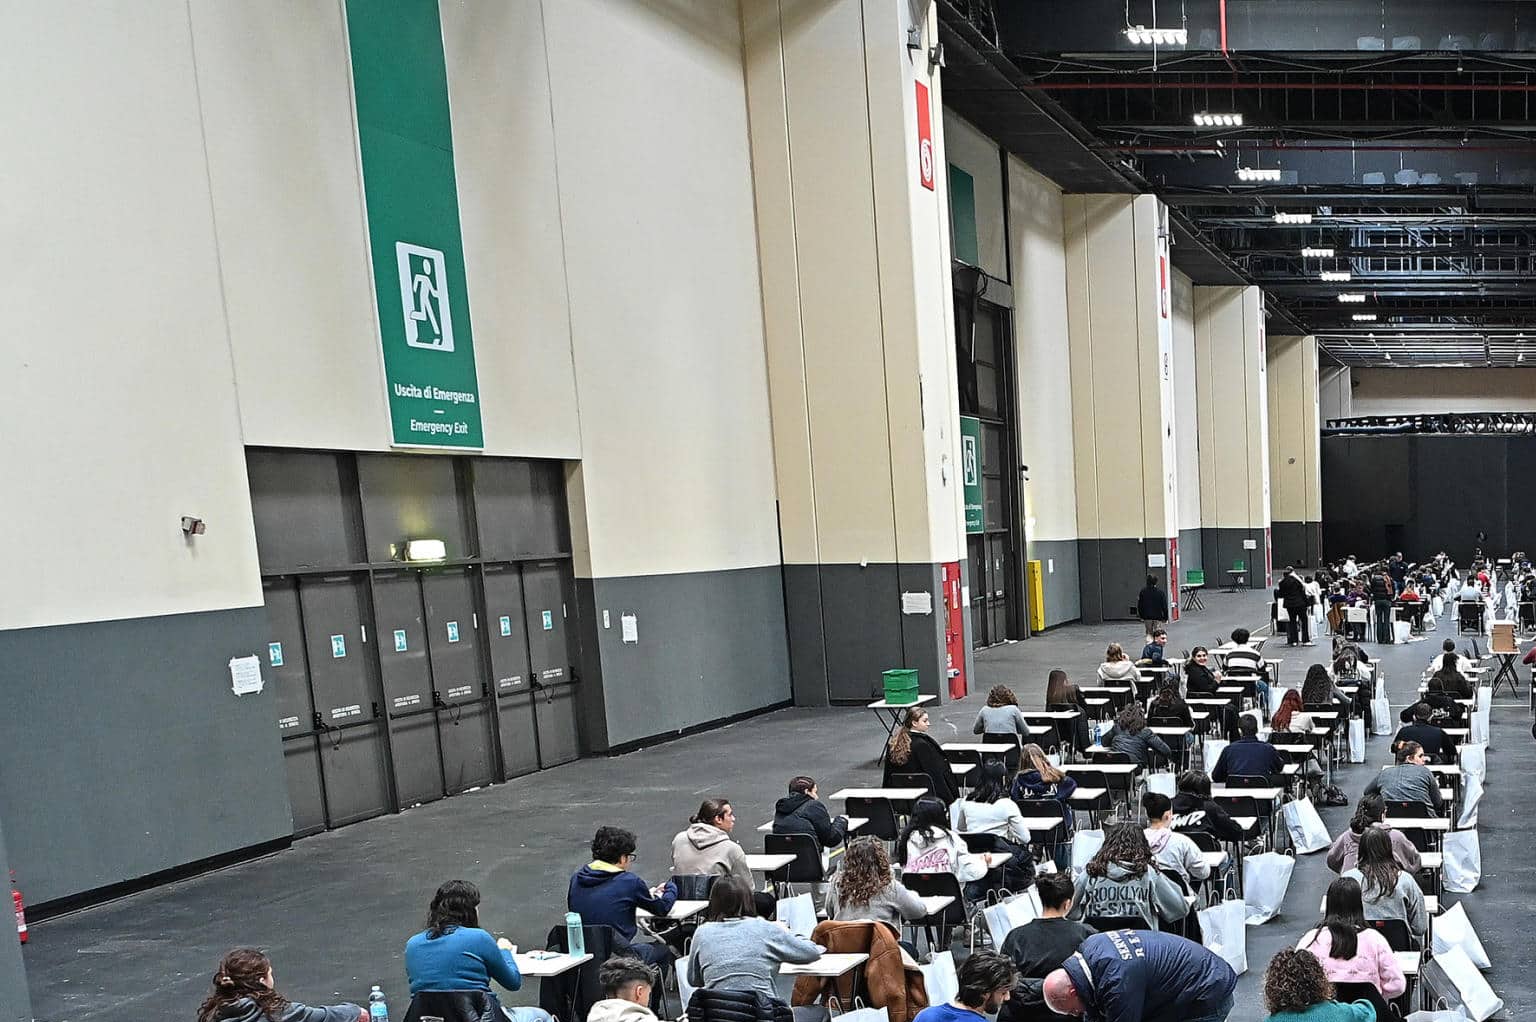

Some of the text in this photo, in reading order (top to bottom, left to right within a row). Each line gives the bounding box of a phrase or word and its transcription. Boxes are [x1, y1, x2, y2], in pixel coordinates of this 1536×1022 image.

[394, 383, 475, 404] Uscita di Emergenza
[410, 419, 468, 436] Emergency Exit
